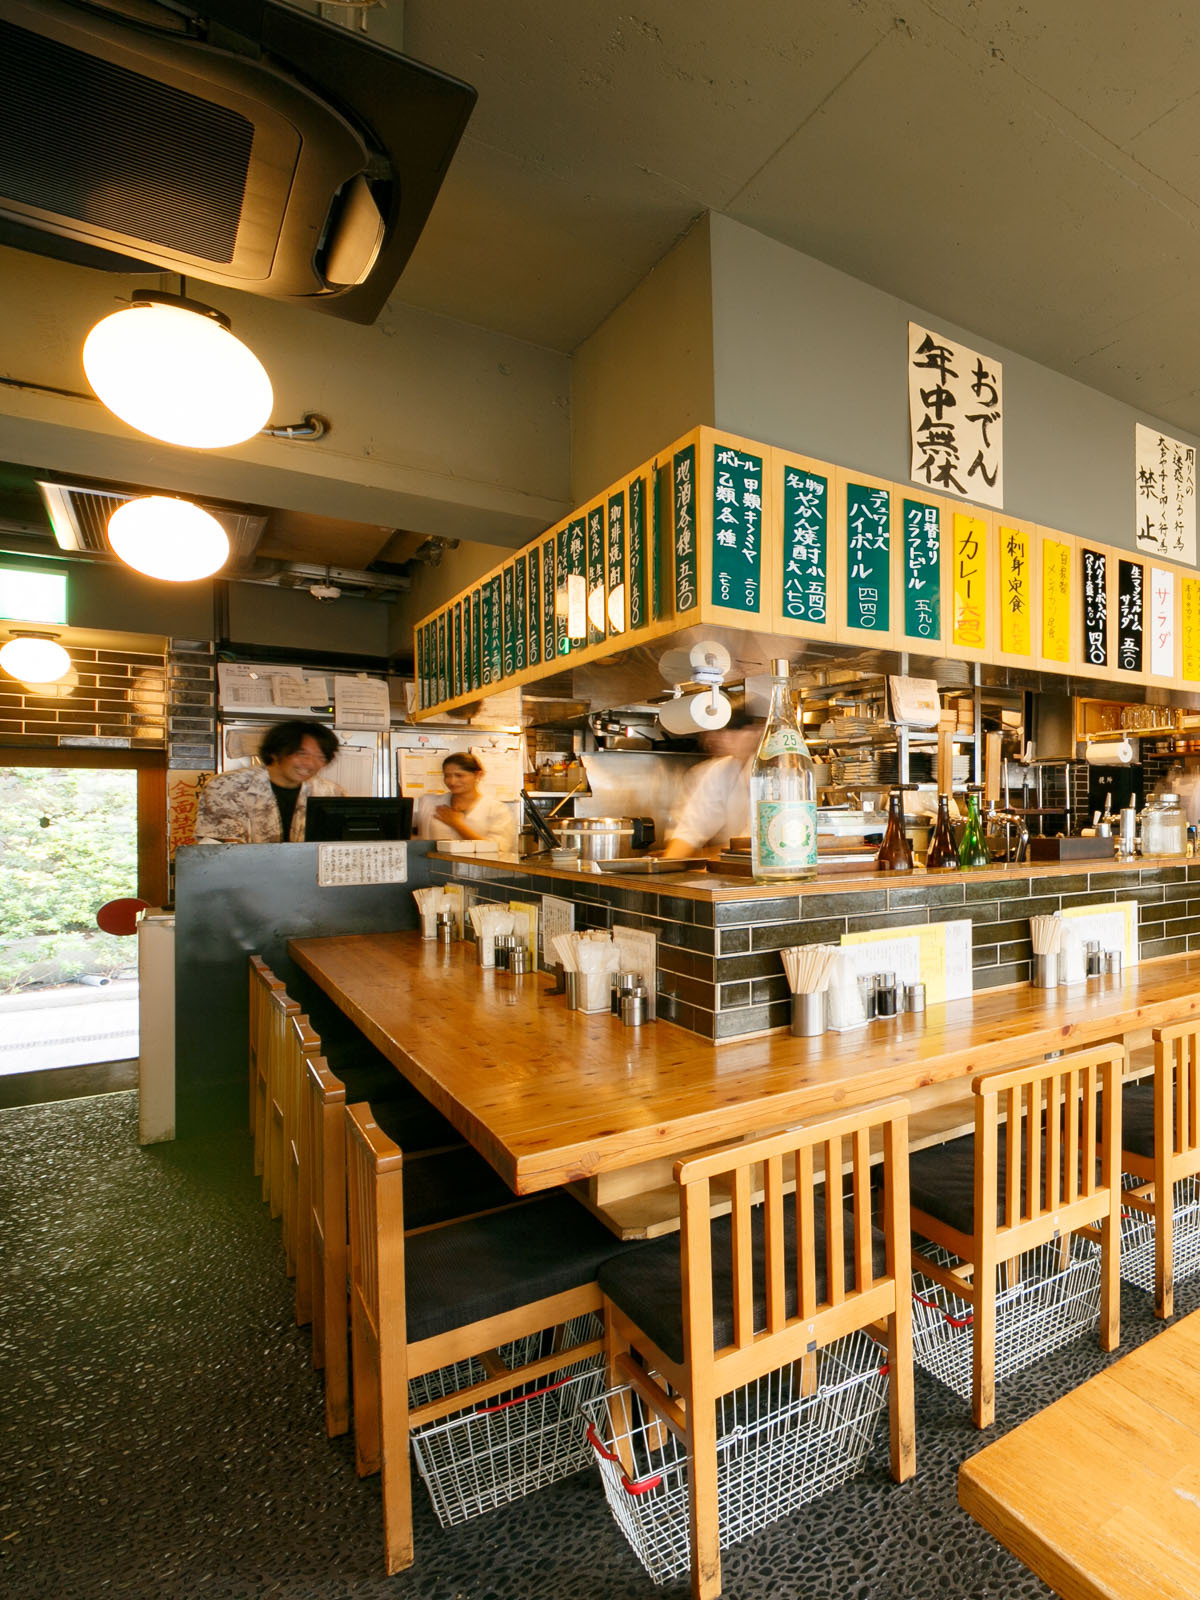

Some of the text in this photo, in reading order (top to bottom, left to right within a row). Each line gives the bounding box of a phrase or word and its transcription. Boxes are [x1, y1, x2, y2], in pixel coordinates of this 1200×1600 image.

[912, 332, 969, 495] 年中無休
[965, 357, 1001, 488] おでん
[716, 451, 761, 473] ボトル
[786, 473, 825, 496] 名物
[1184, 448, 1195, 497] 周りへの
[675, 458, 693, 557] 地酒各種
[715, 471, 740, 549] 乙類各種
[742, 478, 763, 564] 甲類キンミヤ
[849, 502, 874, 579] ハイボール
[923, 508, 940, 566] 日替わり
[1136, 465, 1159, 543] 禁止
[907, 509, 927, 591] クラフトビール
[959, 529, 979, 600] カレー
[1006, 534, 1026, 615] 刺身定食
[1155, 587, 1171, 649] サラダ
[783, 734, 798, 747] 25
